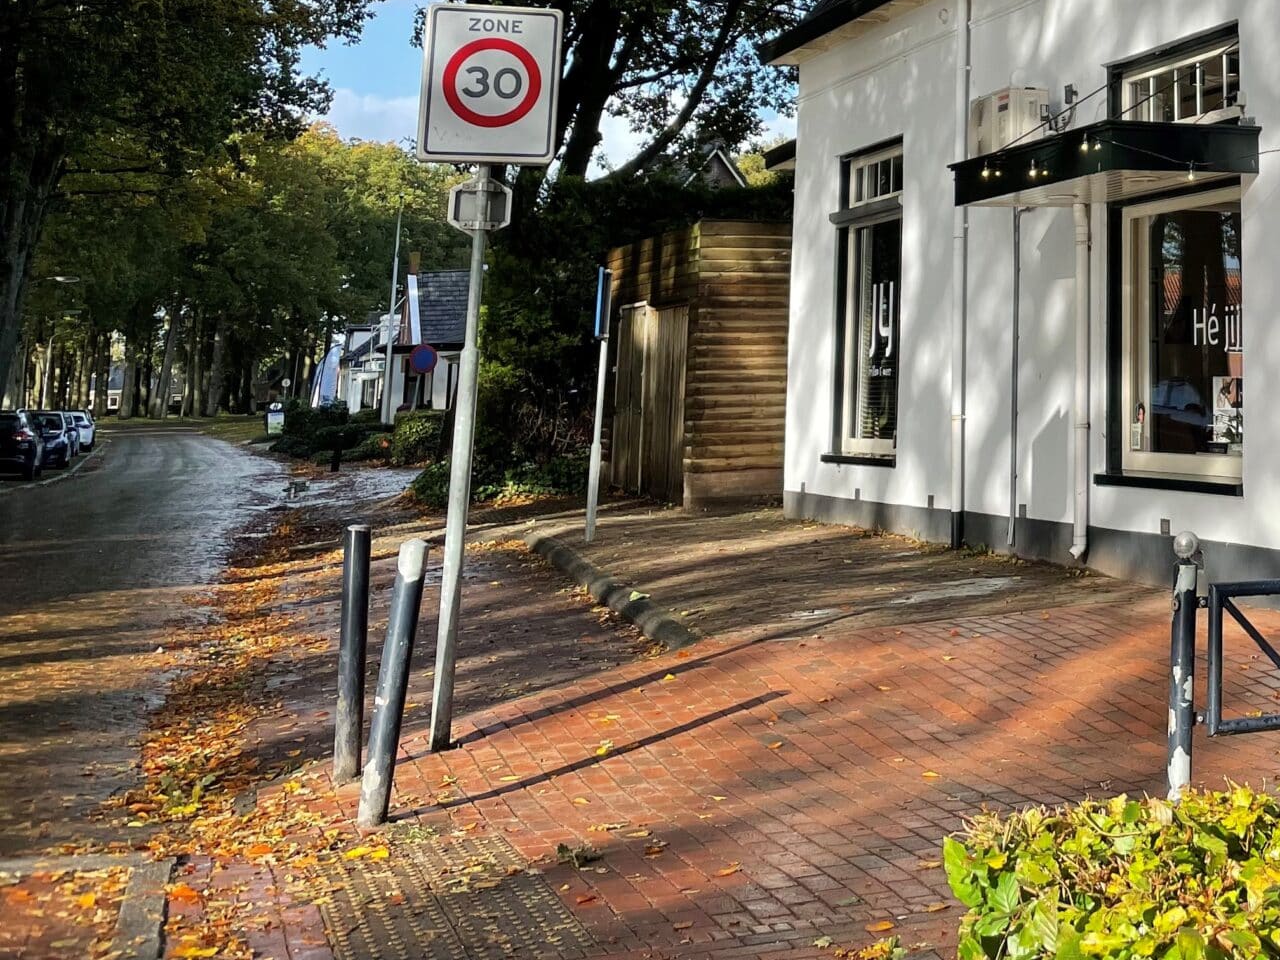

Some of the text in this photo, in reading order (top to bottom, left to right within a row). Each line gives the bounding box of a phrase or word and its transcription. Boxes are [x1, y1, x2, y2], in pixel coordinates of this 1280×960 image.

[468, 17, 523, 34] ZONE
[461, 66, 522, 99] 30
[1192, 303, 1219, 346] Hé
